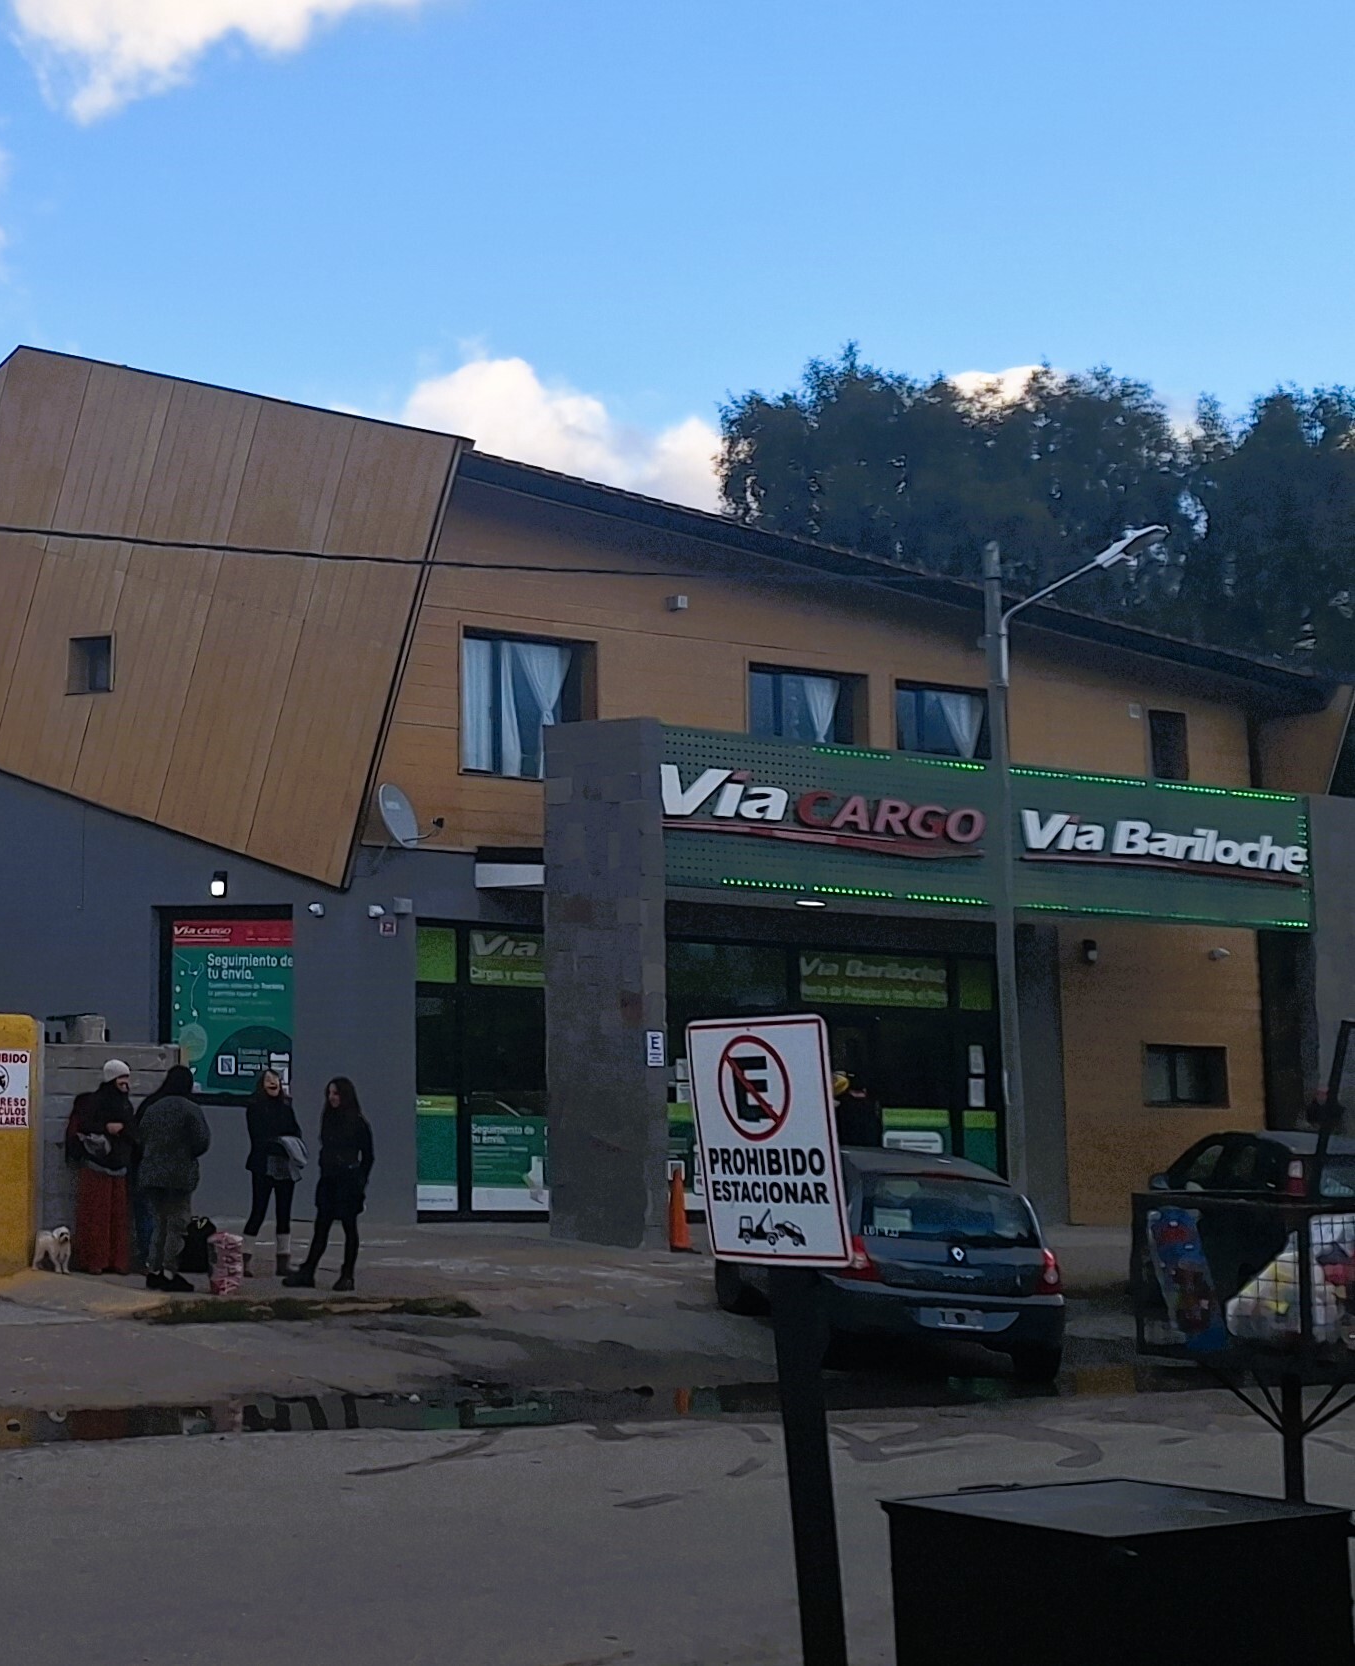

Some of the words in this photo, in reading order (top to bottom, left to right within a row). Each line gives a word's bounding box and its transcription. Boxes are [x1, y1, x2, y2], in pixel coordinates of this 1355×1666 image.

[796, 790, 987, 844] CARGO
[1111, 820, 1309, 874] Bariloche
[196, 927, 232, 936] CARGO
[207, 953, 278, 969] Seguimiento
[279, 953, 294, 967] de
[207, 968, 221, 979] tu
[707, 1147, 826, 1177] PROHIBIDO
[711, 1180, 831, 1205] ESTACIONAR
